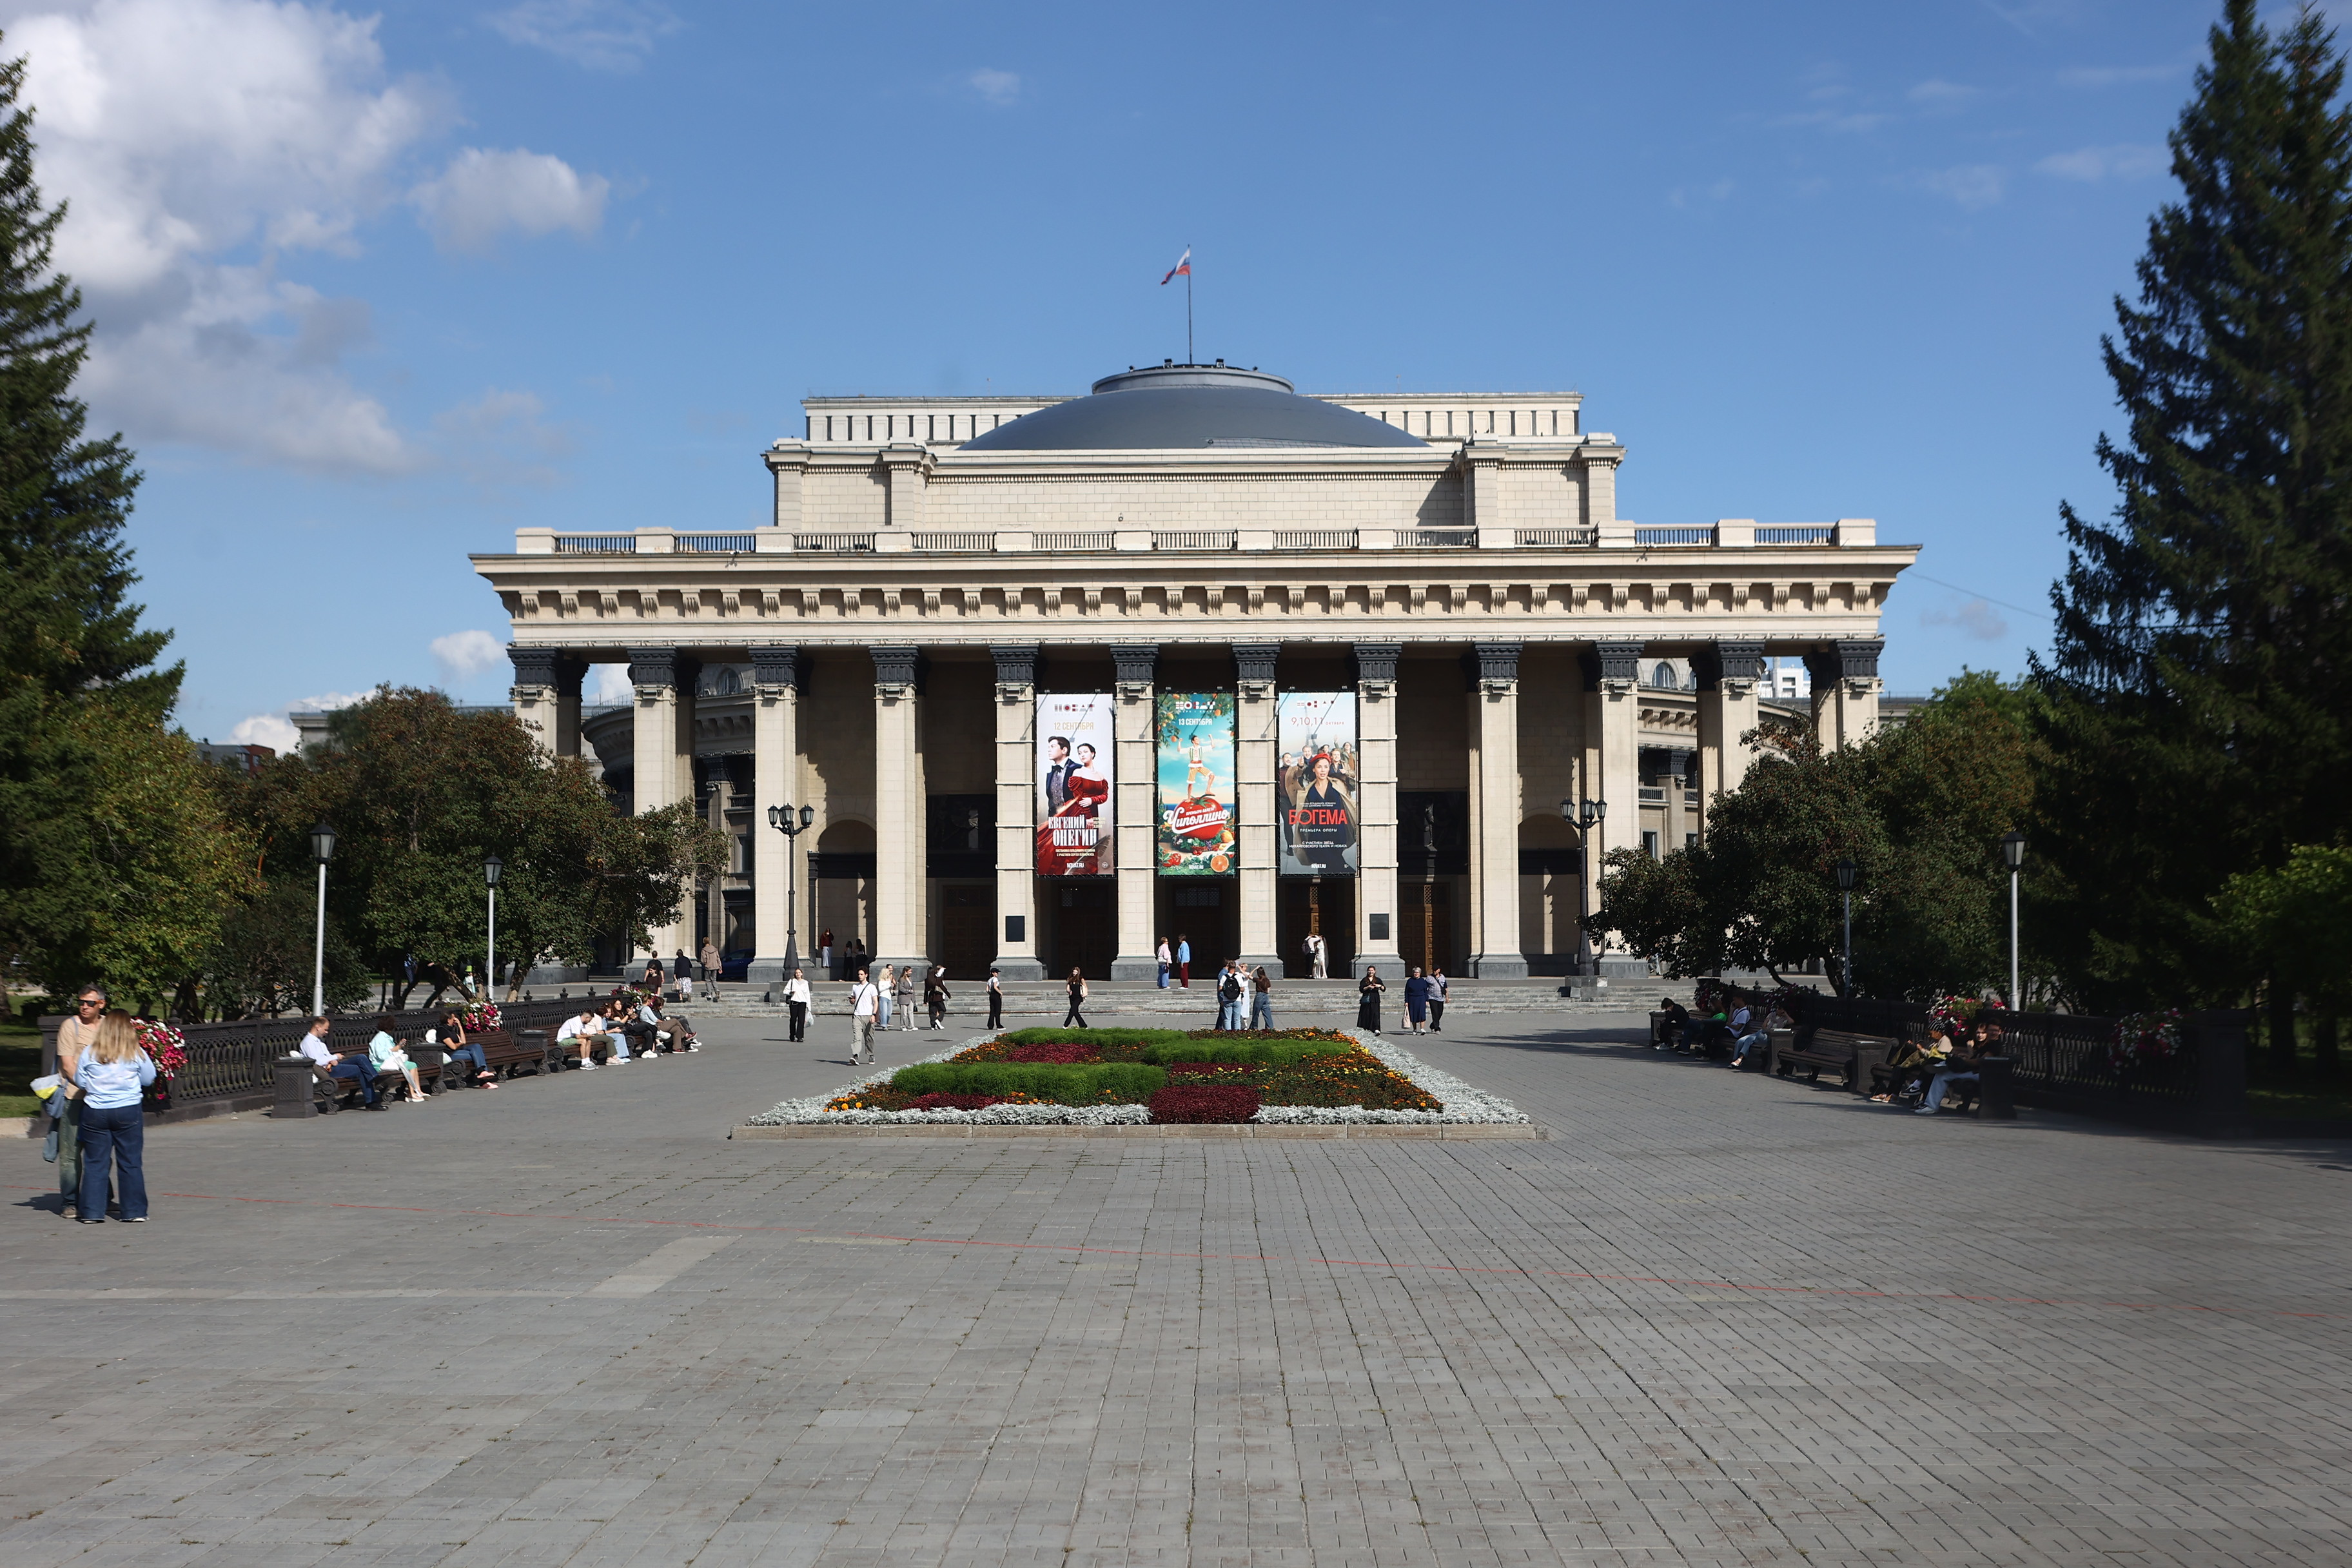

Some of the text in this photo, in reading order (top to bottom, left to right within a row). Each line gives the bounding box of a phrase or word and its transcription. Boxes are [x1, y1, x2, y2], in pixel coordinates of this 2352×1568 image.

[1048, 814, 1085, 829] ЕВГЕНИЙ
[1162, 807, 1230, 834] Чиполлино
[1289, 809, 1348, 825] БОГЕМА
[1053, 828, 1097, 846] ОНЕГИН
